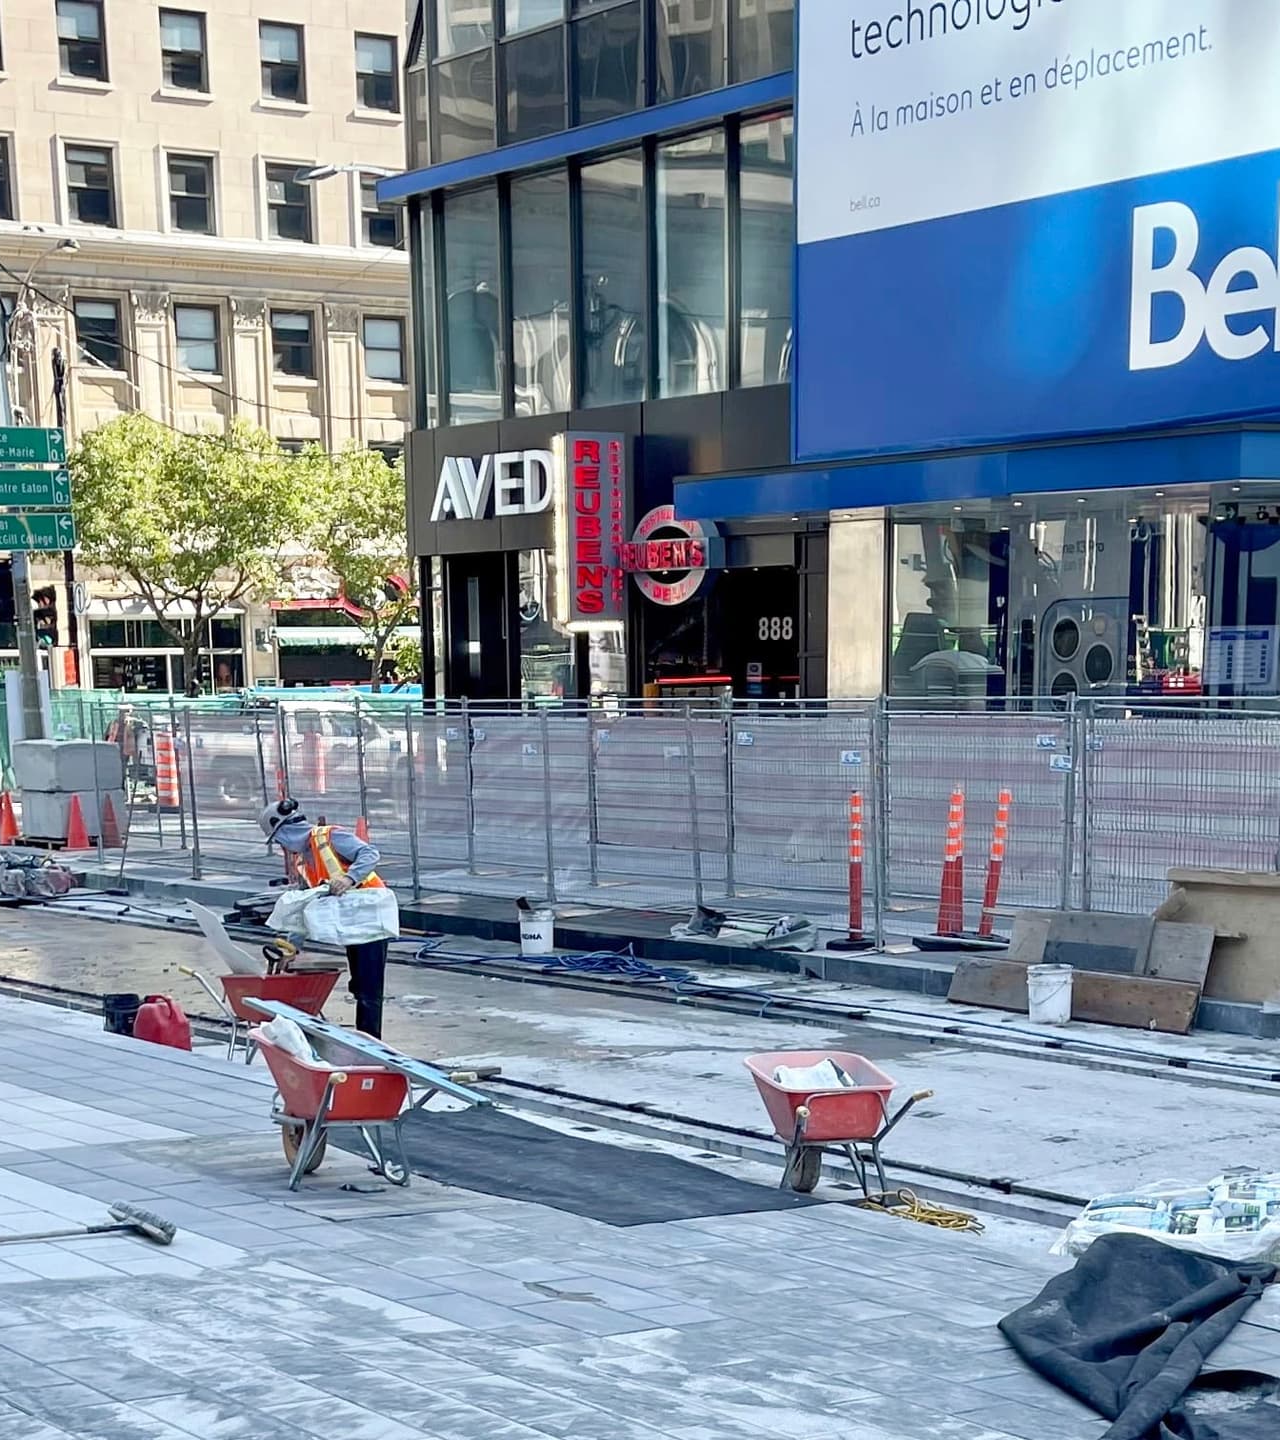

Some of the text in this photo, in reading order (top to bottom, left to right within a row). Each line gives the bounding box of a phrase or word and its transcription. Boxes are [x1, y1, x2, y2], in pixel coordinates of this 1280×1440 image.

[850, 23, 1213, 137] À la maison et en déplacement.
[850, 194, 880, 212] bell.ca
[22, 483, 49, 493] Eaton
[430, 450, 553, 521] AVED
[21, 534, 54, 547] College
[758, 616, 793, 640] 888
